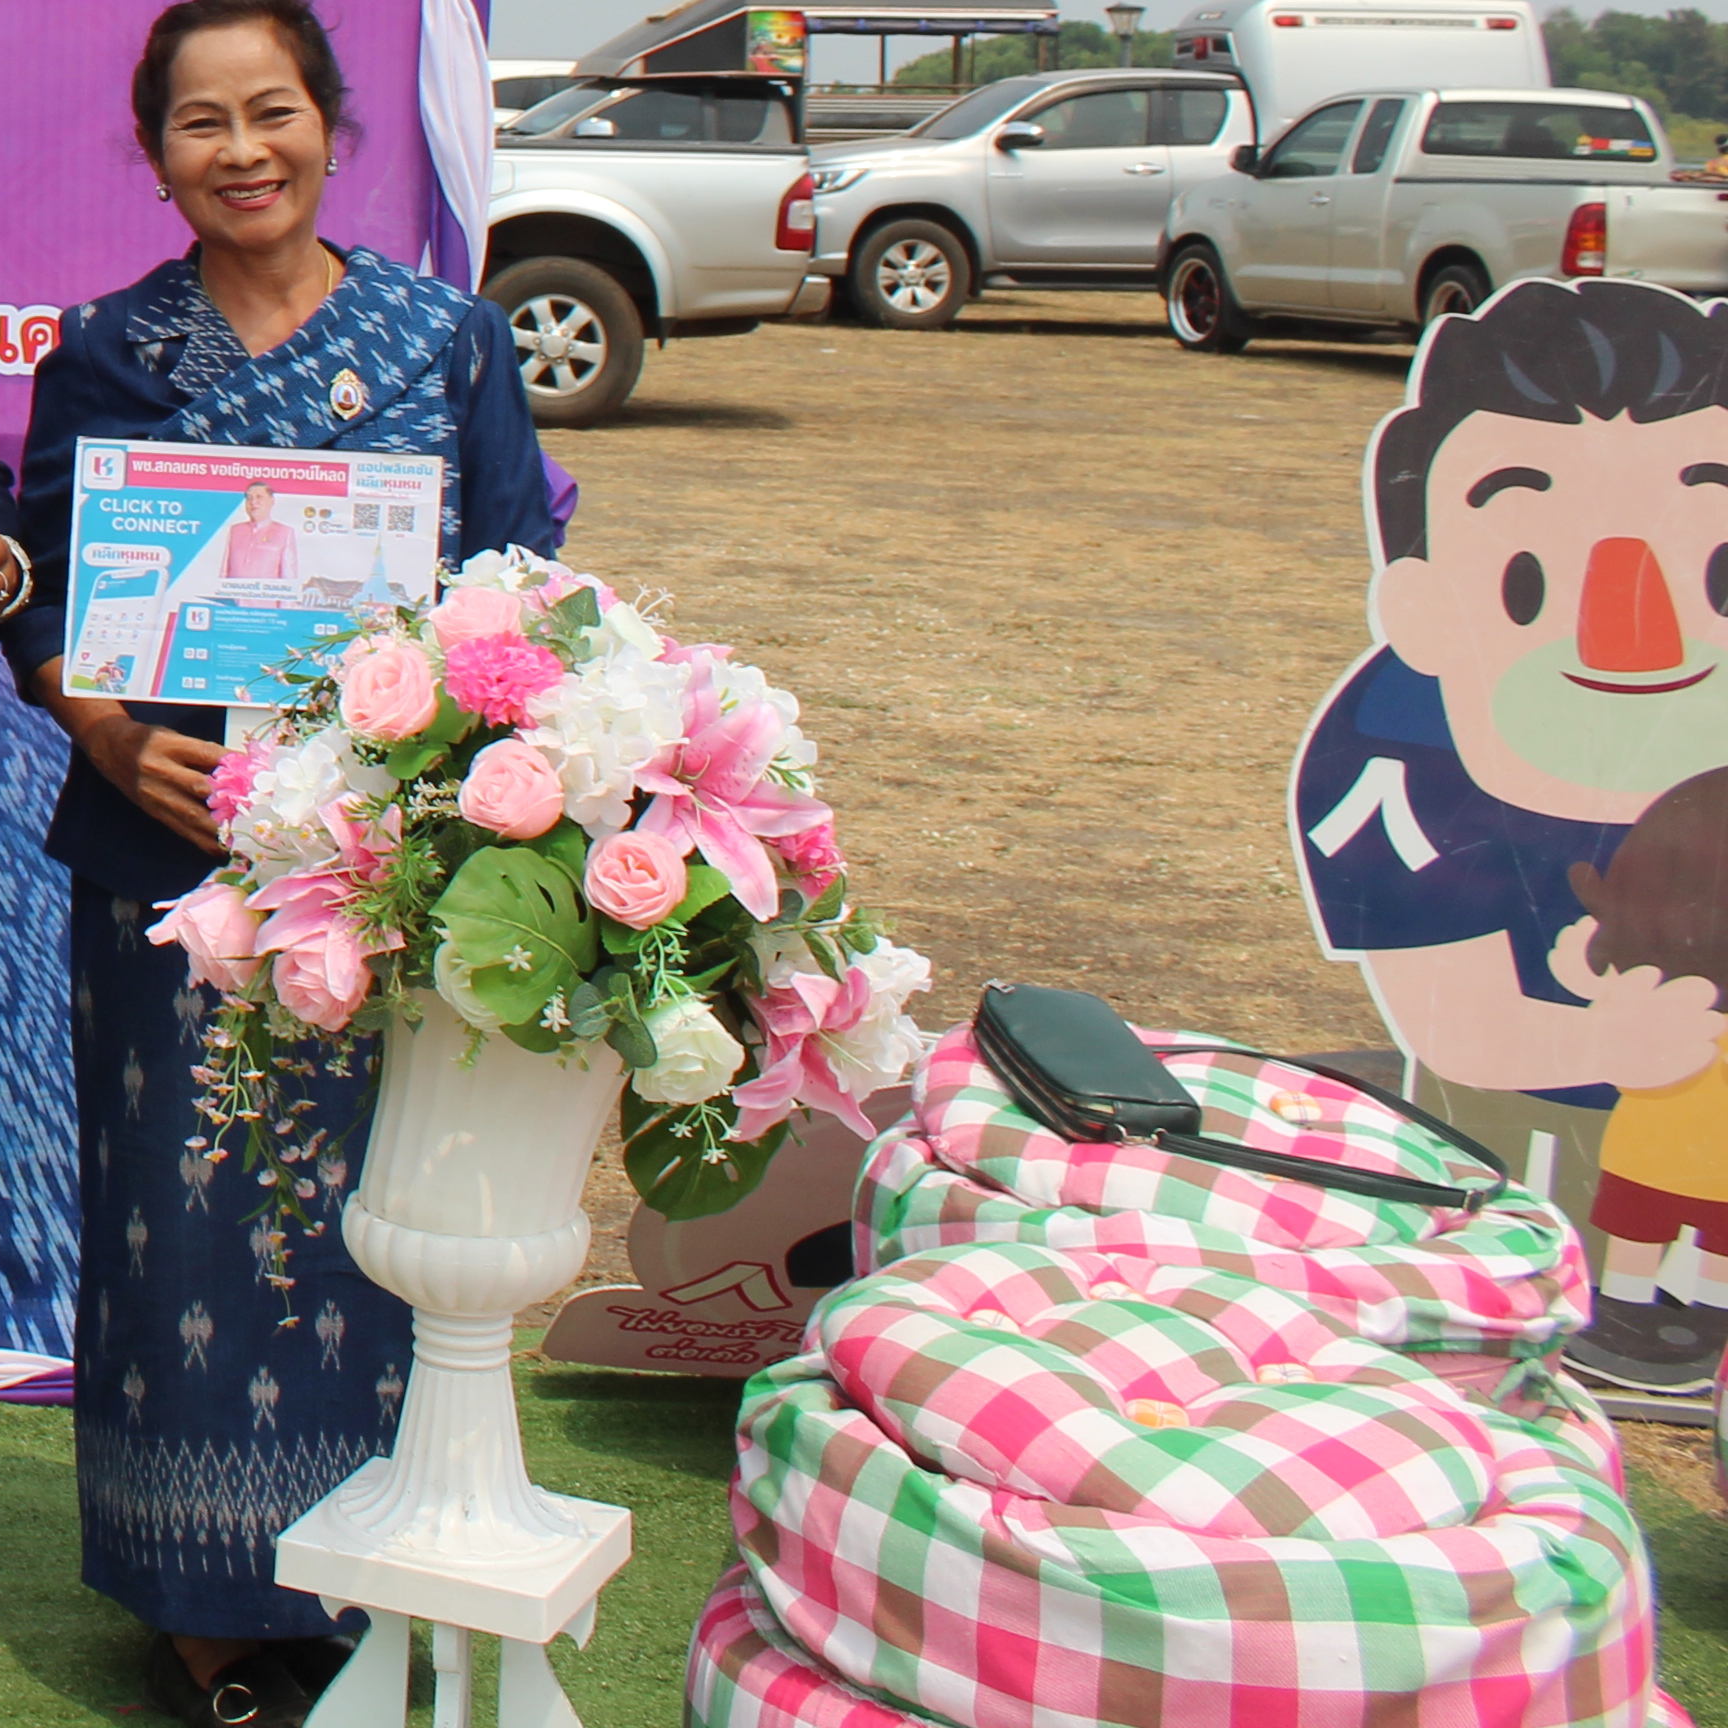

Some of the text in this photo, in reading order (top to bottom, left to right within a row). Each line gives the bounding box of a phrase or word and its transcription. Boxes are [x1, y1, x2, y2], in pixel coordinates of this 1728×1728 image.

[99, 497, 183, 516] CLICK TO
[111, 516, 201, 535] CONNECT
